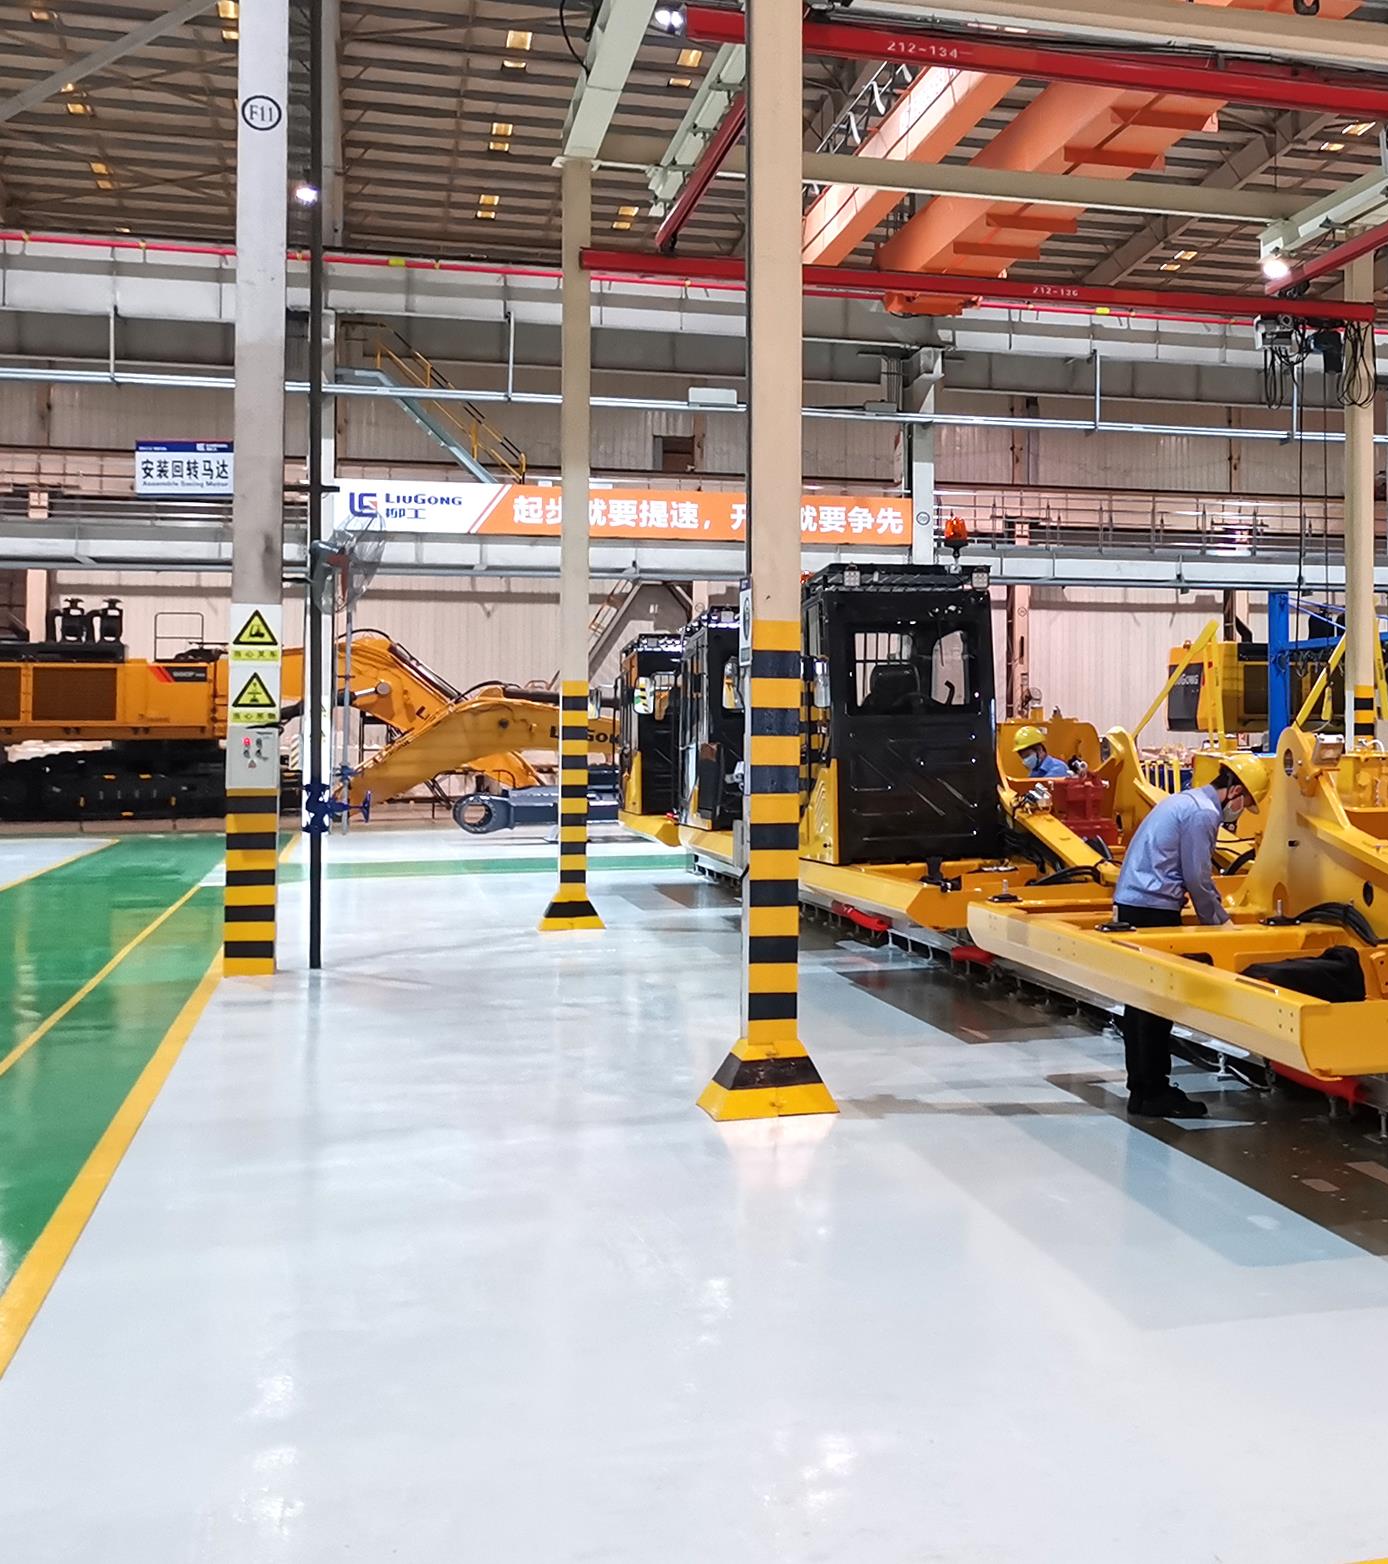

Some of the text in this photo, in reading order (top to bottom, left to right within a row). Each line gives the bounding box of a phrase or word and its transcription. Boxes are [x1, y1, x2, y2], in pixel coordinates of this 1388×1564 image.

[887, 41, 958, 58] 212-134
[250, 104, 273, 122] F11
[141, 459, 229, 479] 安装回转马达
